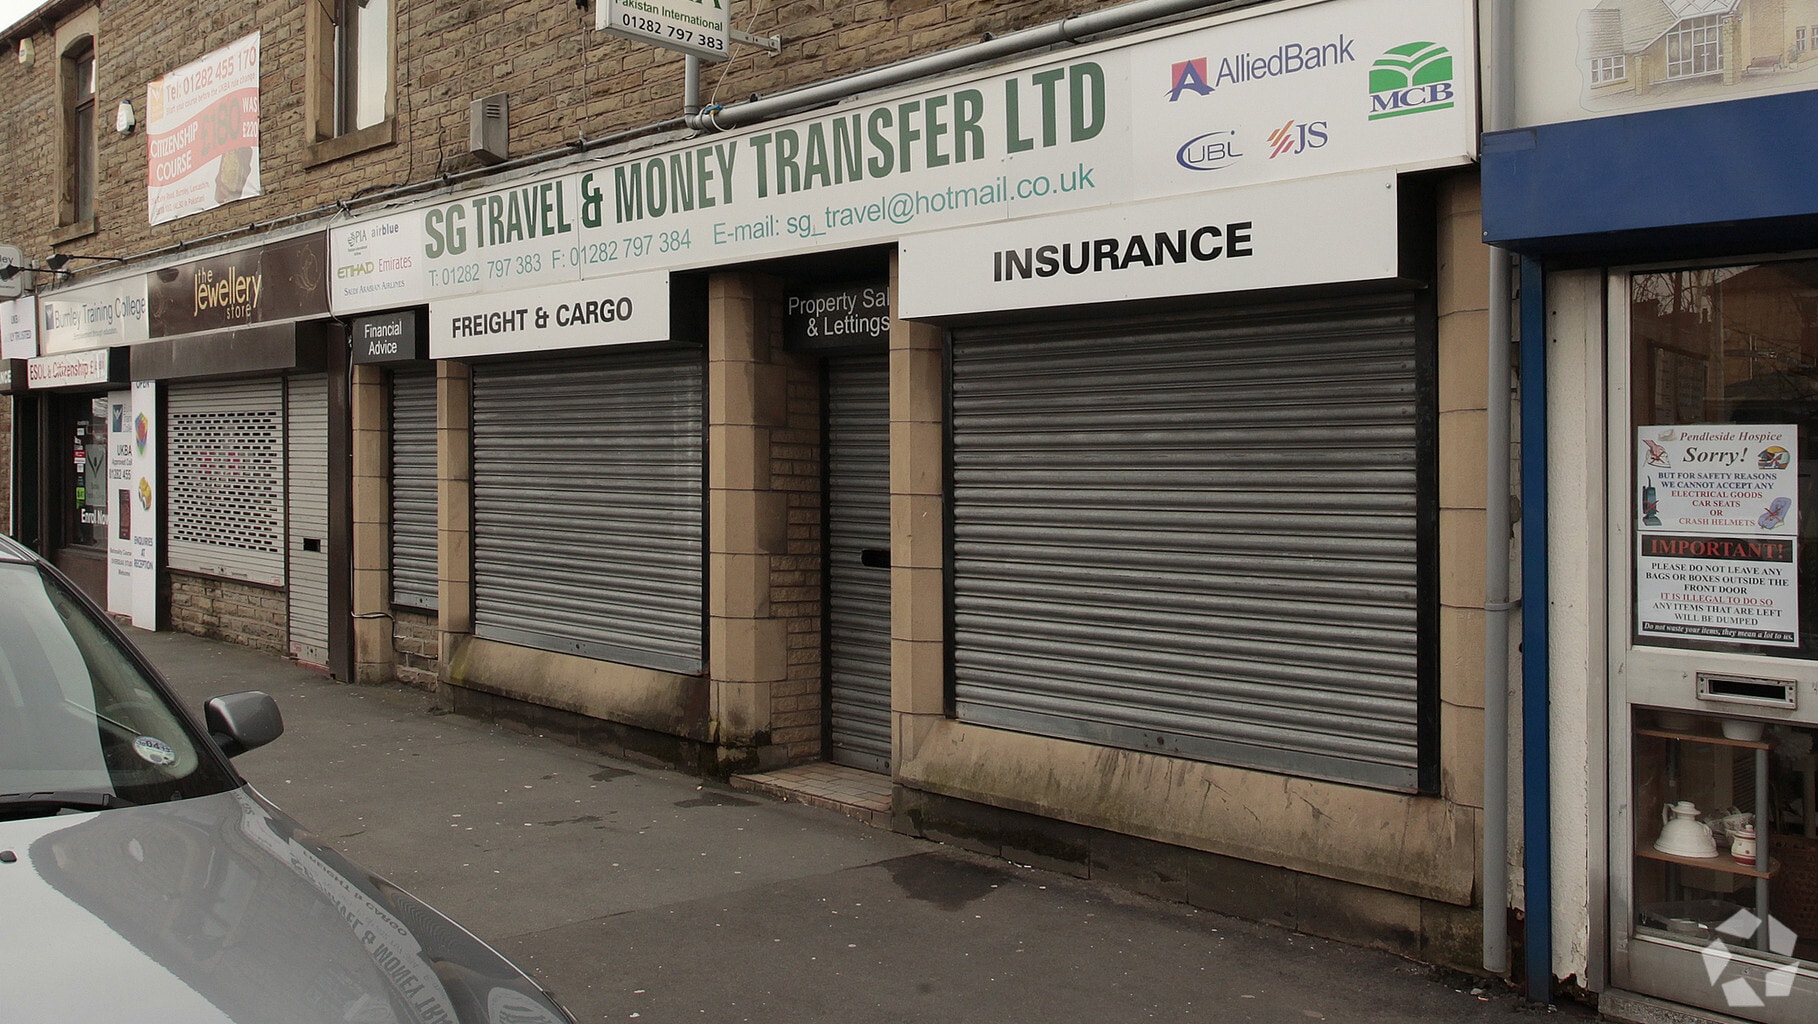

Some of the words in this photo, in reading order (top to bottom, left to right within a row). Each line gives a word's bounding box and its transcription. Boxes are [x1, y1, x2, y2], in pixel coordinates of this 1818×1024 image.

[661, 3, 723, 32] International
[622, 12, 662, 36] 01282
[667, 25, 694, 43] 797
[697, 32, 724, 51] 383
[1215, 33, 1356, 87] AlliedBank
[166, 82, 183, 103] Tel:
[183, 66, 213, 94] 01282
[215, 55, 235, 79] 455
[238, 46, 257, 72] 170
[242, 97, 258, 113] WAS
[1369, 82, 1454, 113] MCB
[242, 121, 258, 138] £220
[1294, 120, 1329, 155] JS
[150, 120, 199, 159] CITIZENSHIP
[156, 150, 192, 182] COURSE
[425, 203, 467, 259] SG
[472, 179, 572, 248] TRAVEL
[580, 172, 603, 228] &
[614, 140, 738, 225] MONEY
[749, 87, 985, 199] TRANSFER
[1005, 60, 1106, 155] LTD
[713, 214, 780, 245] E-mail:
[786, 162, 1096, 239] sg_travel@hotmail.co.uk
[371, 222, 400, 238] airblue
[428, 269, 440, 288] T:
[441, 263, 480, 287] 01282
[487, 258, 512, 279] 797
[514, 253, 542, 275] 383
[551, 248, 566, 269] F:
[569, 240, 618, 266] 01282
[623, 234, 654, 259] 797
[659, 228, 692, 254] 384
[993, 221, 1254, 282] INSURANCE
[198, 266, 213, 283] the
[337, 261, 375, 280] ETIHAD
[378, 255, 413, 273] Emirates
[788, 290, 858, 318] Property
[862, 286, 890, 307] Sal
[54, 308, 81, 331] Burnley
[82, 302, 113, 325] Training
[114, 296, 146, 320] College
[226, 303, 252, 320] store
[452, 307, 528, 339] FREIGHT
[535, 306, 550, 329] &
[556, 296, 633, 327] CARGO
[364, 320, 402, 339] Financial
[806, 318, 819, 337] &
[823, 313, 890, 338] Lettings
[368, 339, 398, 356] Advice
[30, 363, 47, 381] ESOL
[52, 359, 89, 379] Citizenship
[1679, 431, 1735, 442] Pendleside
[1738, 431, 1783, 443] Hospice
[1682, 446, 1749, 466] Sorry!
[1658, 471, 1676, 480] BUT
[1677, 471, 1696, 480] FOR
[1697, 472, 1732, 480] SAFETY
[1733, 472, 1777, 481] REASONS
[1660, 480, 1676, 489] WE
[1677, 480, 1716, 489] CANNOT
[1716, 481, 1753, 490] ACCEPT
[1754, 482, 1774, 490] ANY
[1671, 490, 1729, 499] ELECTRICAL
[1730, 491, 1763, 500] GOODS
[1692, 499, 1712, 507] CAR
[1713, 500, 1741, 508] SEATS
[81, 508, 97, 524] Enrol
[1678, 517, 1709, 526] CRASH
[1711, 518, 1756, 527] HELMETS
[1709, 509, 1724, 517] OR
[1651, 538, 1784, 559] IMPORTANT!
[1651, 562, 1687, 571] PLEASE
[1689, 564, 1704, 572] DO
[1704, 564, 1726, 573] NOT
[1727, 566, 1761, 575] LEAVE
[1762, 567, 1783, 576] ANY
[1646, 572, 1670, 581] BAGS
[1672, 573, 1687, 582] OR
[1688, 574, 1721, 583] BOXES
[1722, 576, 1767, 585] OUTSIDE
[1768, 578, 1789, 586] THE
[1684, 584, 1717, 593] FRONT
[1718, 585, 1748, 595] DOOR
[1660, 592, 1671, 600] IT
[1681, 593, 1725, 603] ILLEGAL
[1726, 595, 1741, 604] TO
[1742, 596, 1758, 605] DO
[1759, 597, 1774, 606] SO
[1653, 602, 1673, 610] ANY
[1674, 603, 1704, 612] ITEMS
[1705, 605, 1733, 614] THAT
[1734, 606, 1754, 615] ARE
[1756, 608, 1783, 617] LEFT
[1675, 612, 1699, 622] WILL
[1701, 615, 1714, 623] BE
[1716, 616, 1759, 626] DUMPED
[1644, 622, 1652, 630] Do
[1666, 624, 1684, 632] waste
[1684, 627, 1701, 635] your
[1701, 627, 1721, 636] items,
[1721, 628, 1737, 637] they
